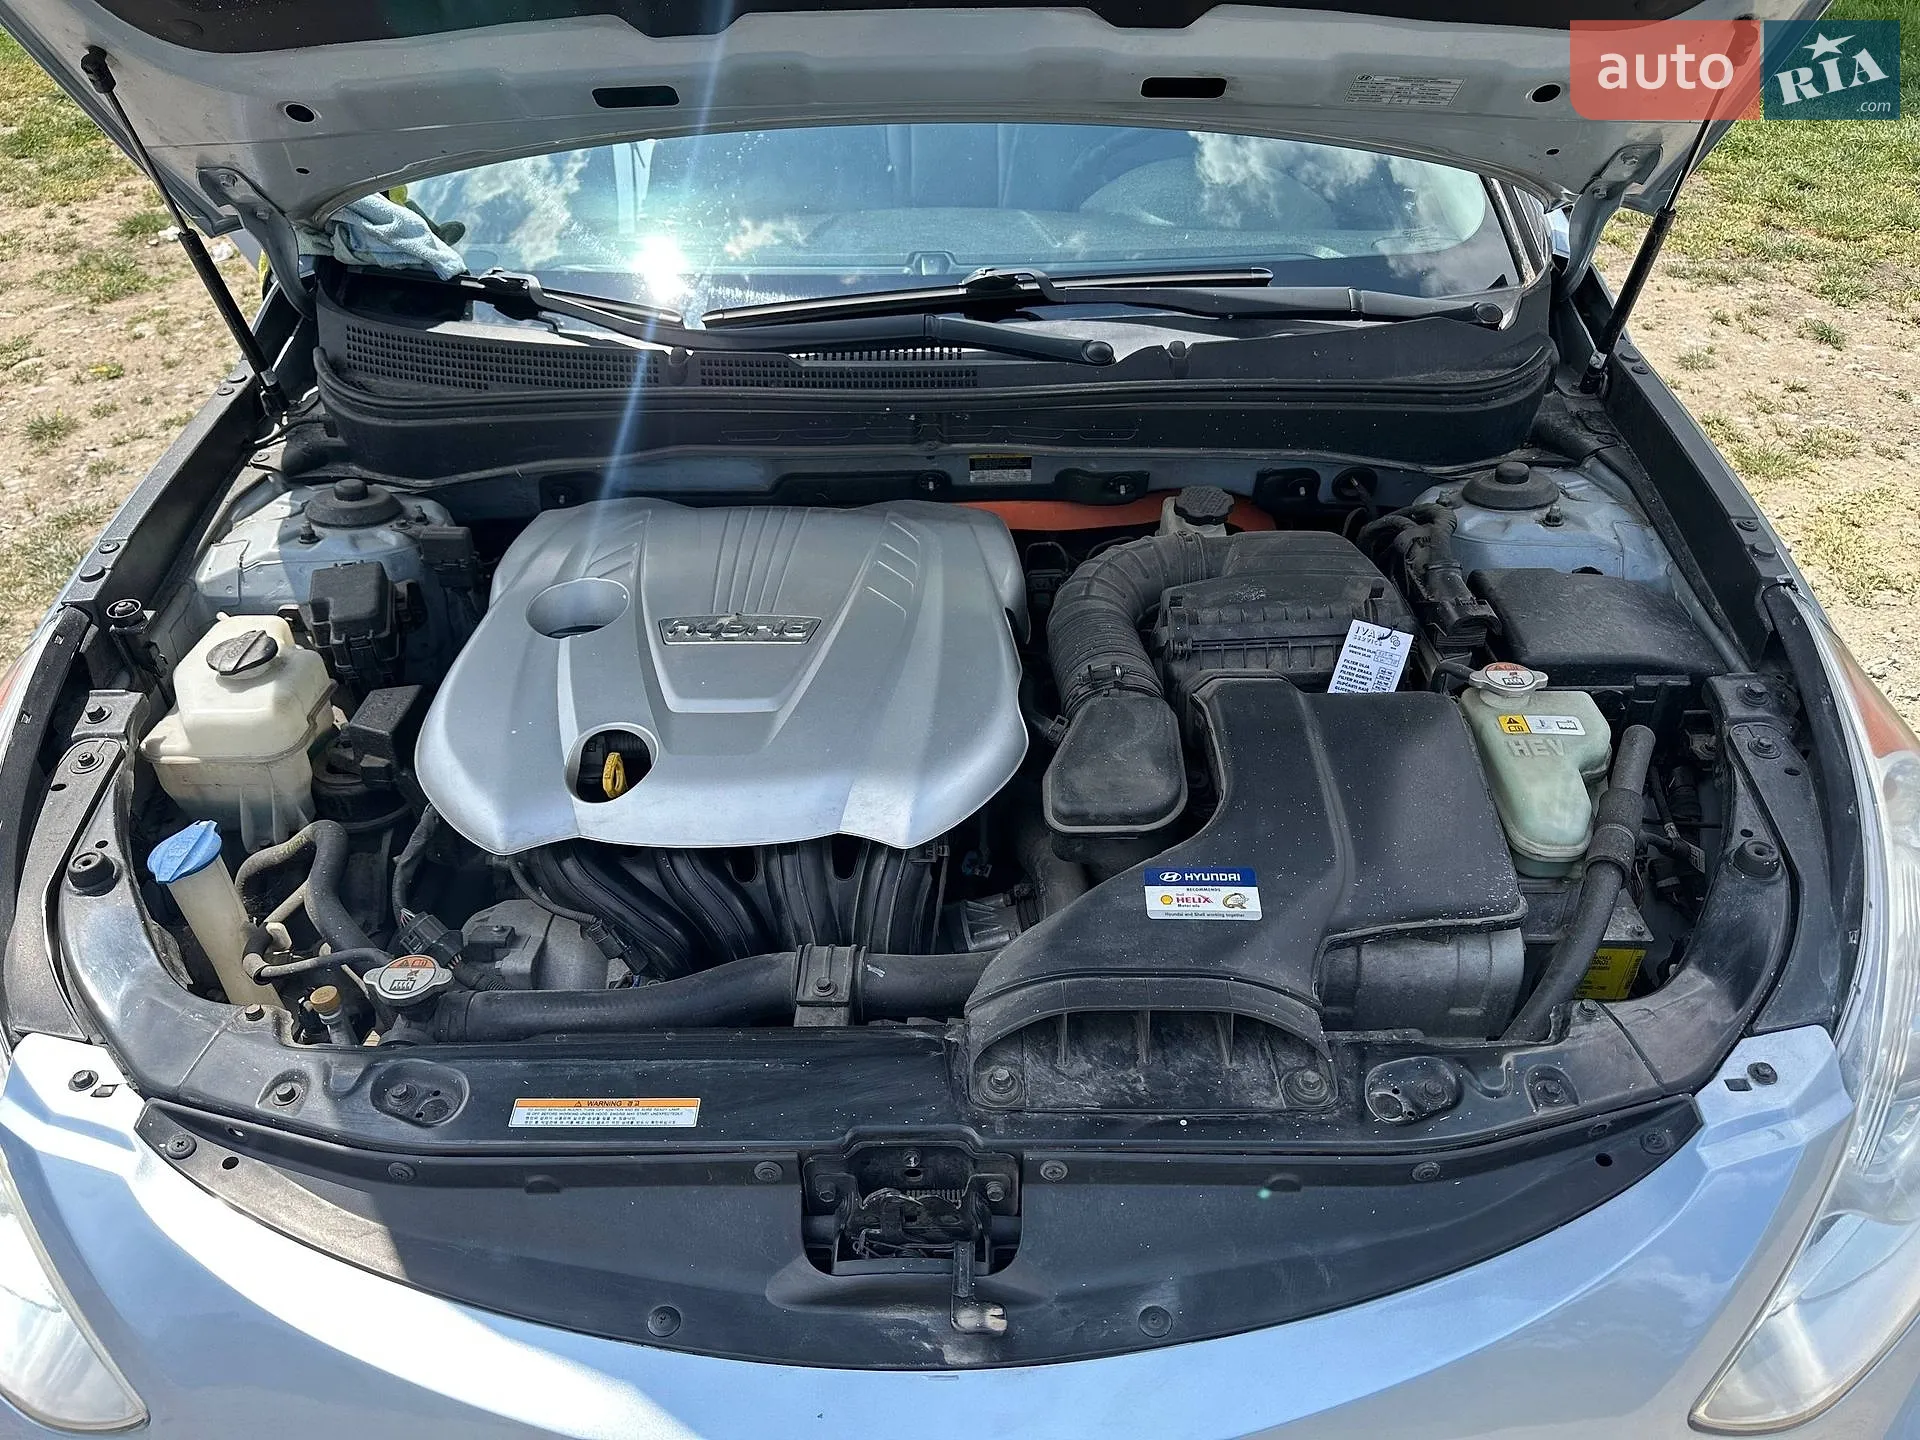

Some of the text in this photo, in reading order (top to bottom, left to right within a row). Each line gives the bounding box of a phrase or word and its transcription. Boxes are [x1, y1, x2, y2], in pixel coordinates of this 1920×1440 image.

[667, 620, 813, 640] hybrid
[1507, 738, 1565, 757] HEV
[1184, 873, 1241, 882] HYUNDAI
